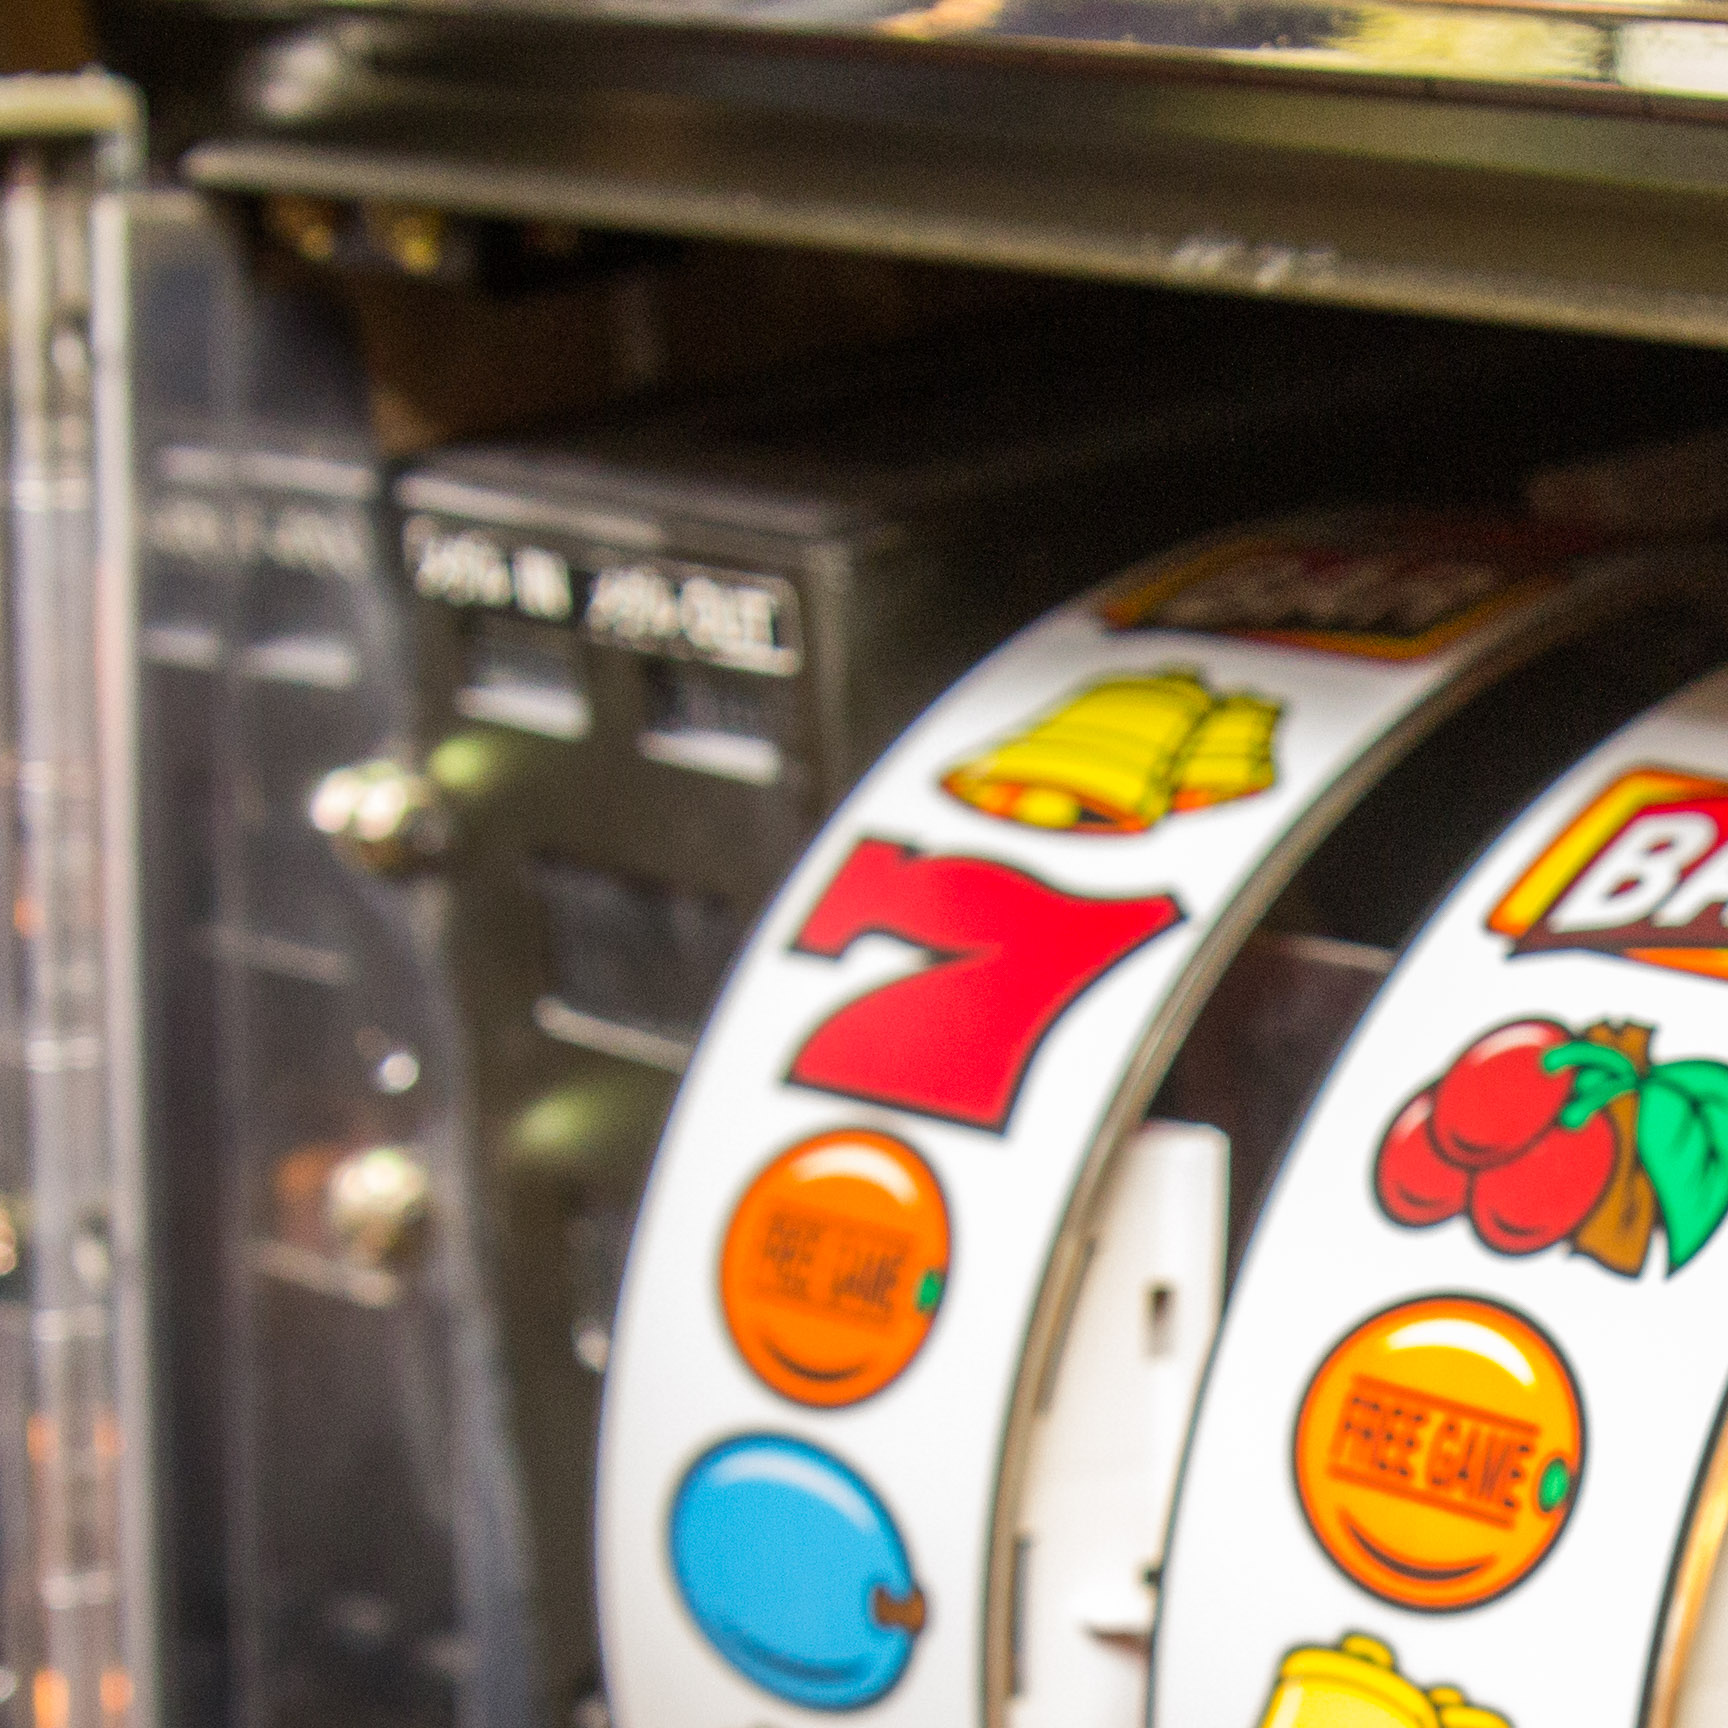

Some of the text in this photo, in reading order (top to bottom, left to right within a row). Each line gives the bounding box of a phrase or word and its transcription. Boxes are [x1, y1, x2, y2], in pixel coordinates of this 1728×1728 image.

[786, 836, 1189, 1136] 7
[1330, 1395, 1532, 1510] FREE GAME
